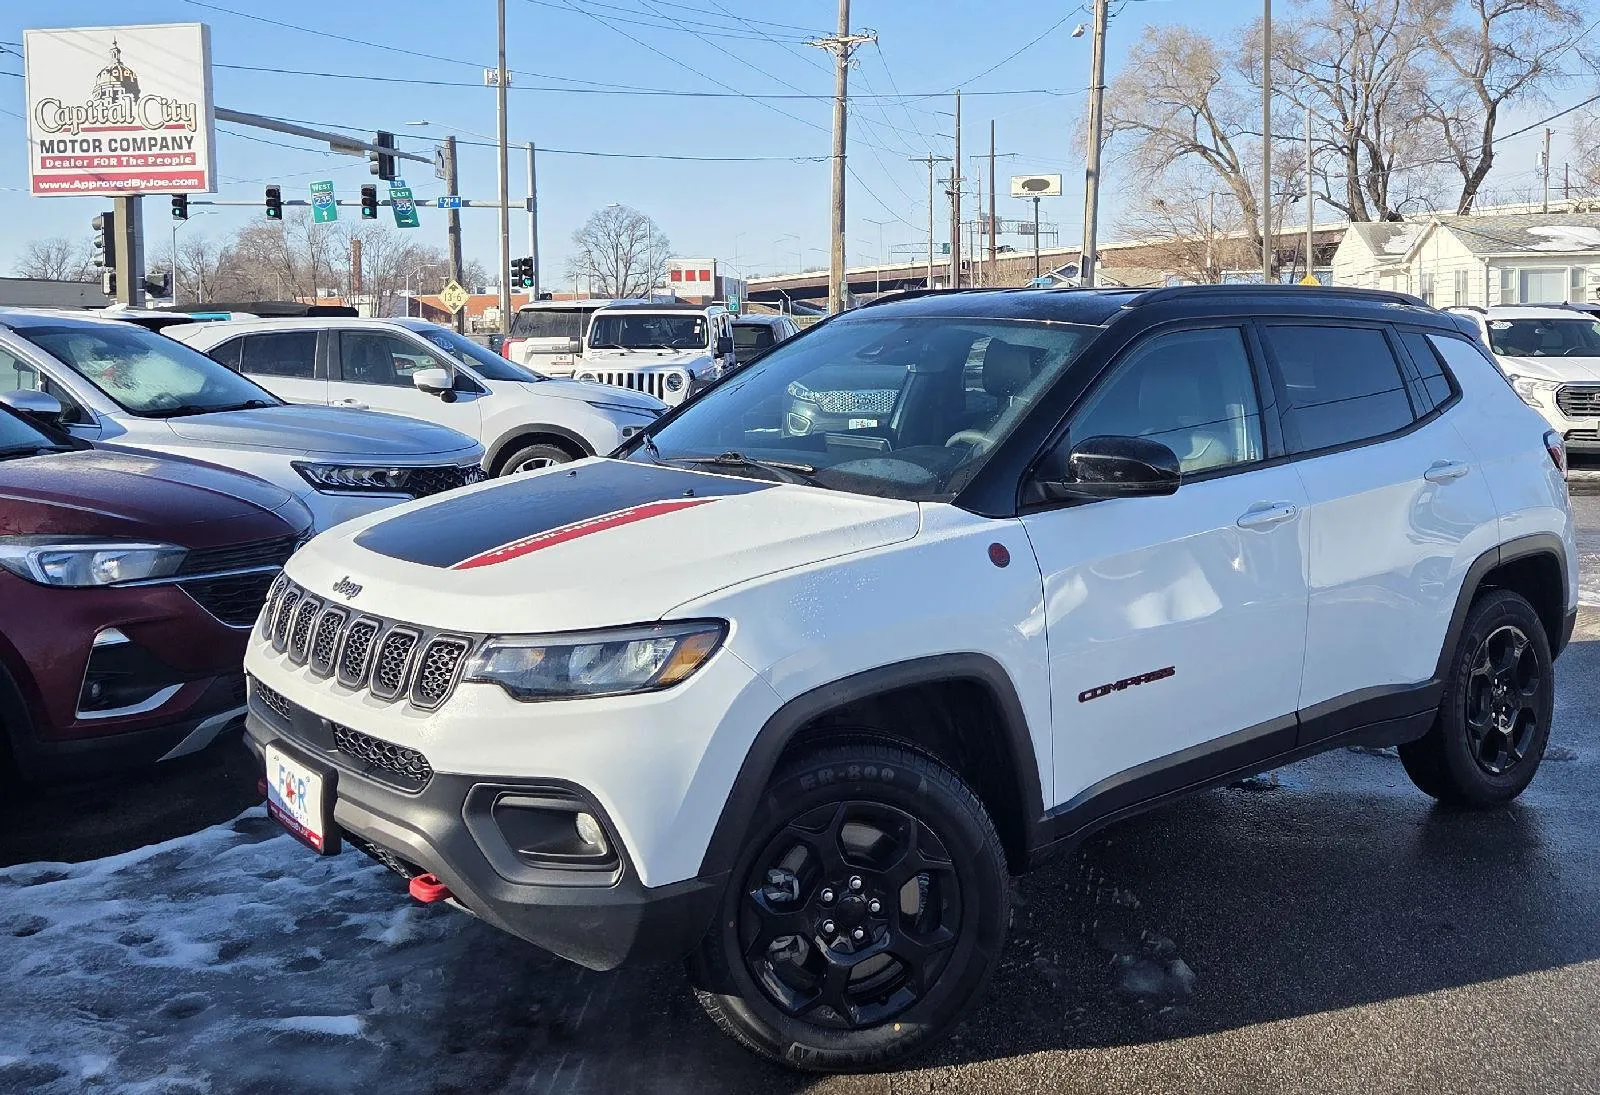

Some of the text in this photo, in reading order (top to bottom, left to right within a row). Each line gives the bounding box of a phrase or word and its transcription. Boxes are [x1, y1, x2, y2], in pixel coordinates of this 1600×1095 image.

[35, 94, 197, 135] Capital City
[40, 136, 194, 153] MOTOR COMPANY
[46, 155, 193, 168] Dealer FOR The People
[39, 178, 198, 189] www.ApprovedByJoe.com
[315, 196, 332, 204] 235
[333, 575, 363, 601] Jeep
[1078, 666, 1175, 703] COMPASS
